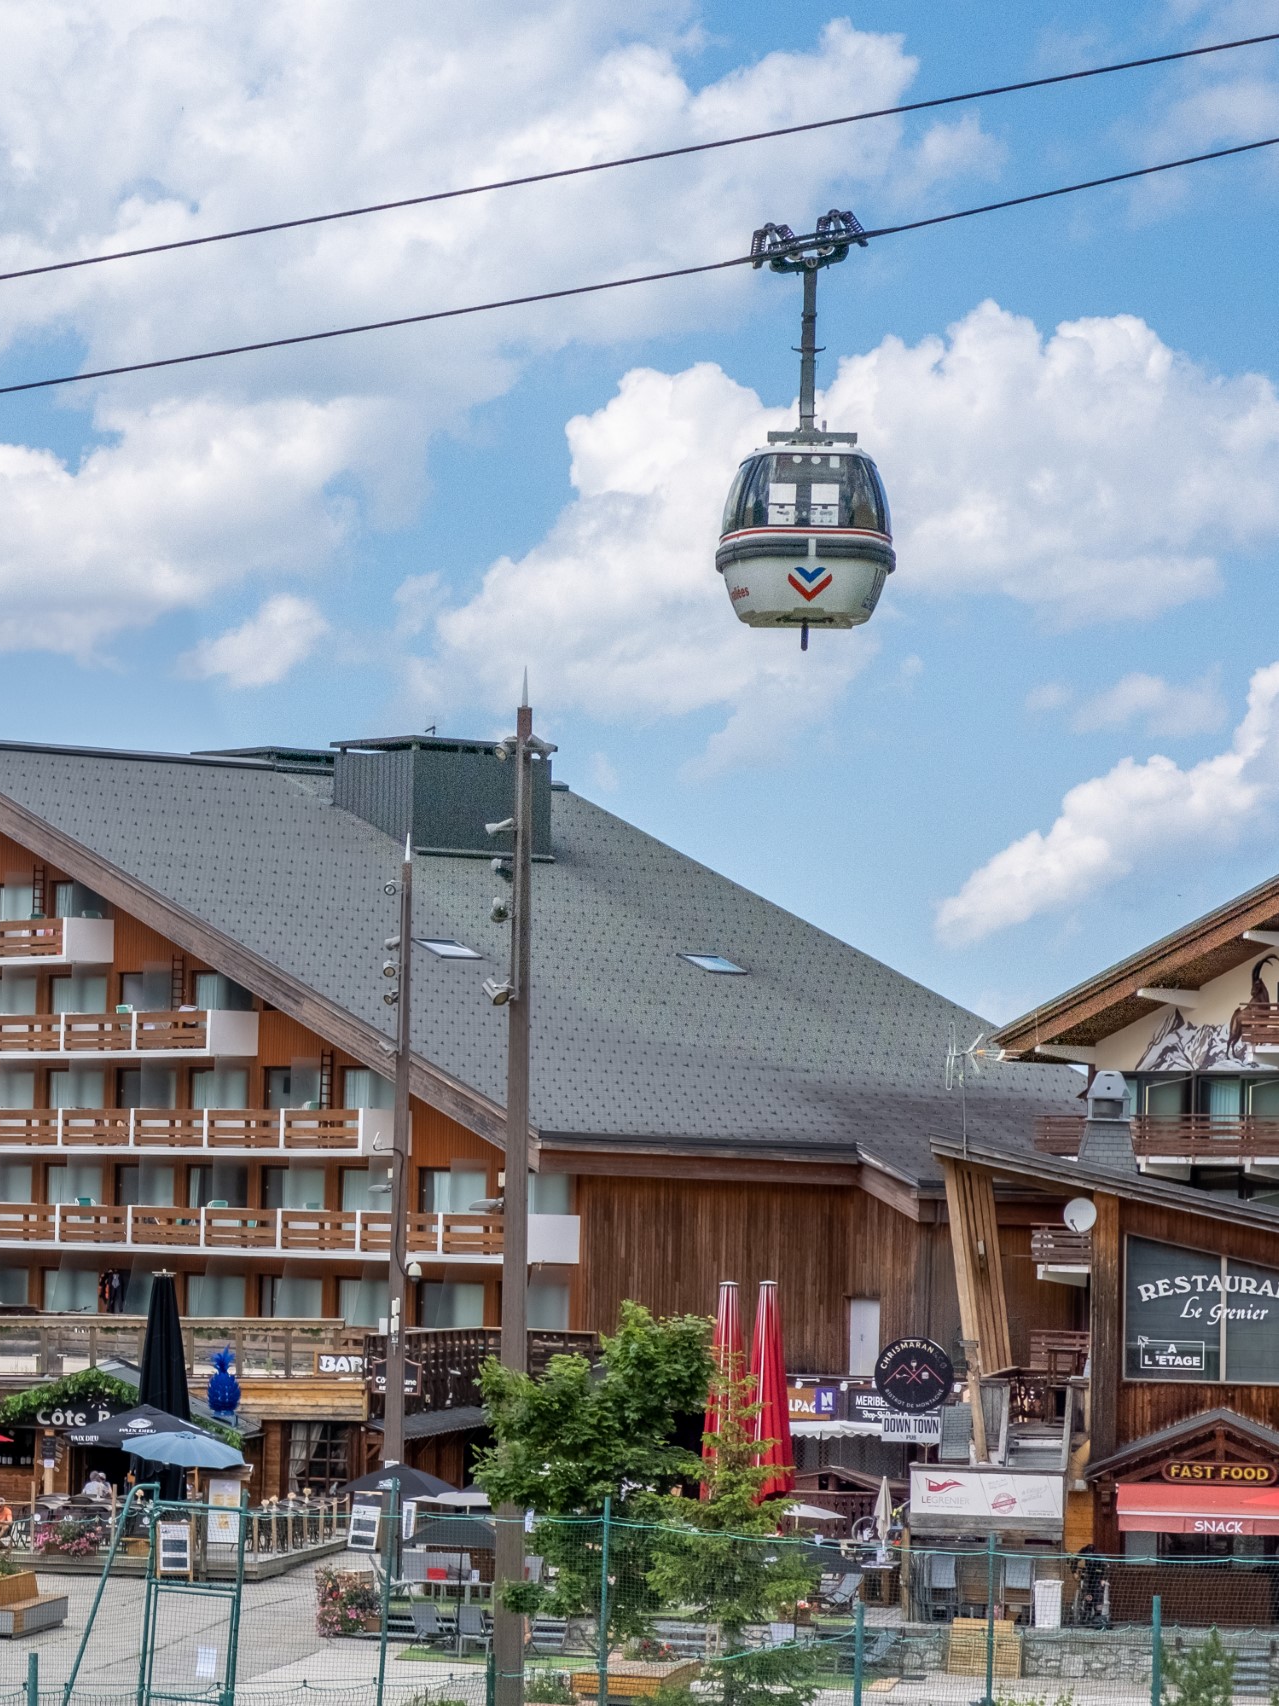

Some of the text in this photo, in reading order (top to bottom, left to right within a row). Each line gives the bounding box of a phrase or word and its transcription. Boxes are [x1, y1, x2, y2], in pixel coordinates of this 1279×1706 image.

[1137, 1275, 1279, 1302] RESTAURA
[1180, 1296, 1269, 1325] Le Grenier
[1167, 1344, 1177, 1353] A
[36, 1407, 87, 1427] Côte
[884, 1418, 939, 1434] DOWN TOWN
[1170, 1465, 1269, 1481] FAST FOOD
[1194, 1520, 1243, 1533] SNACK
